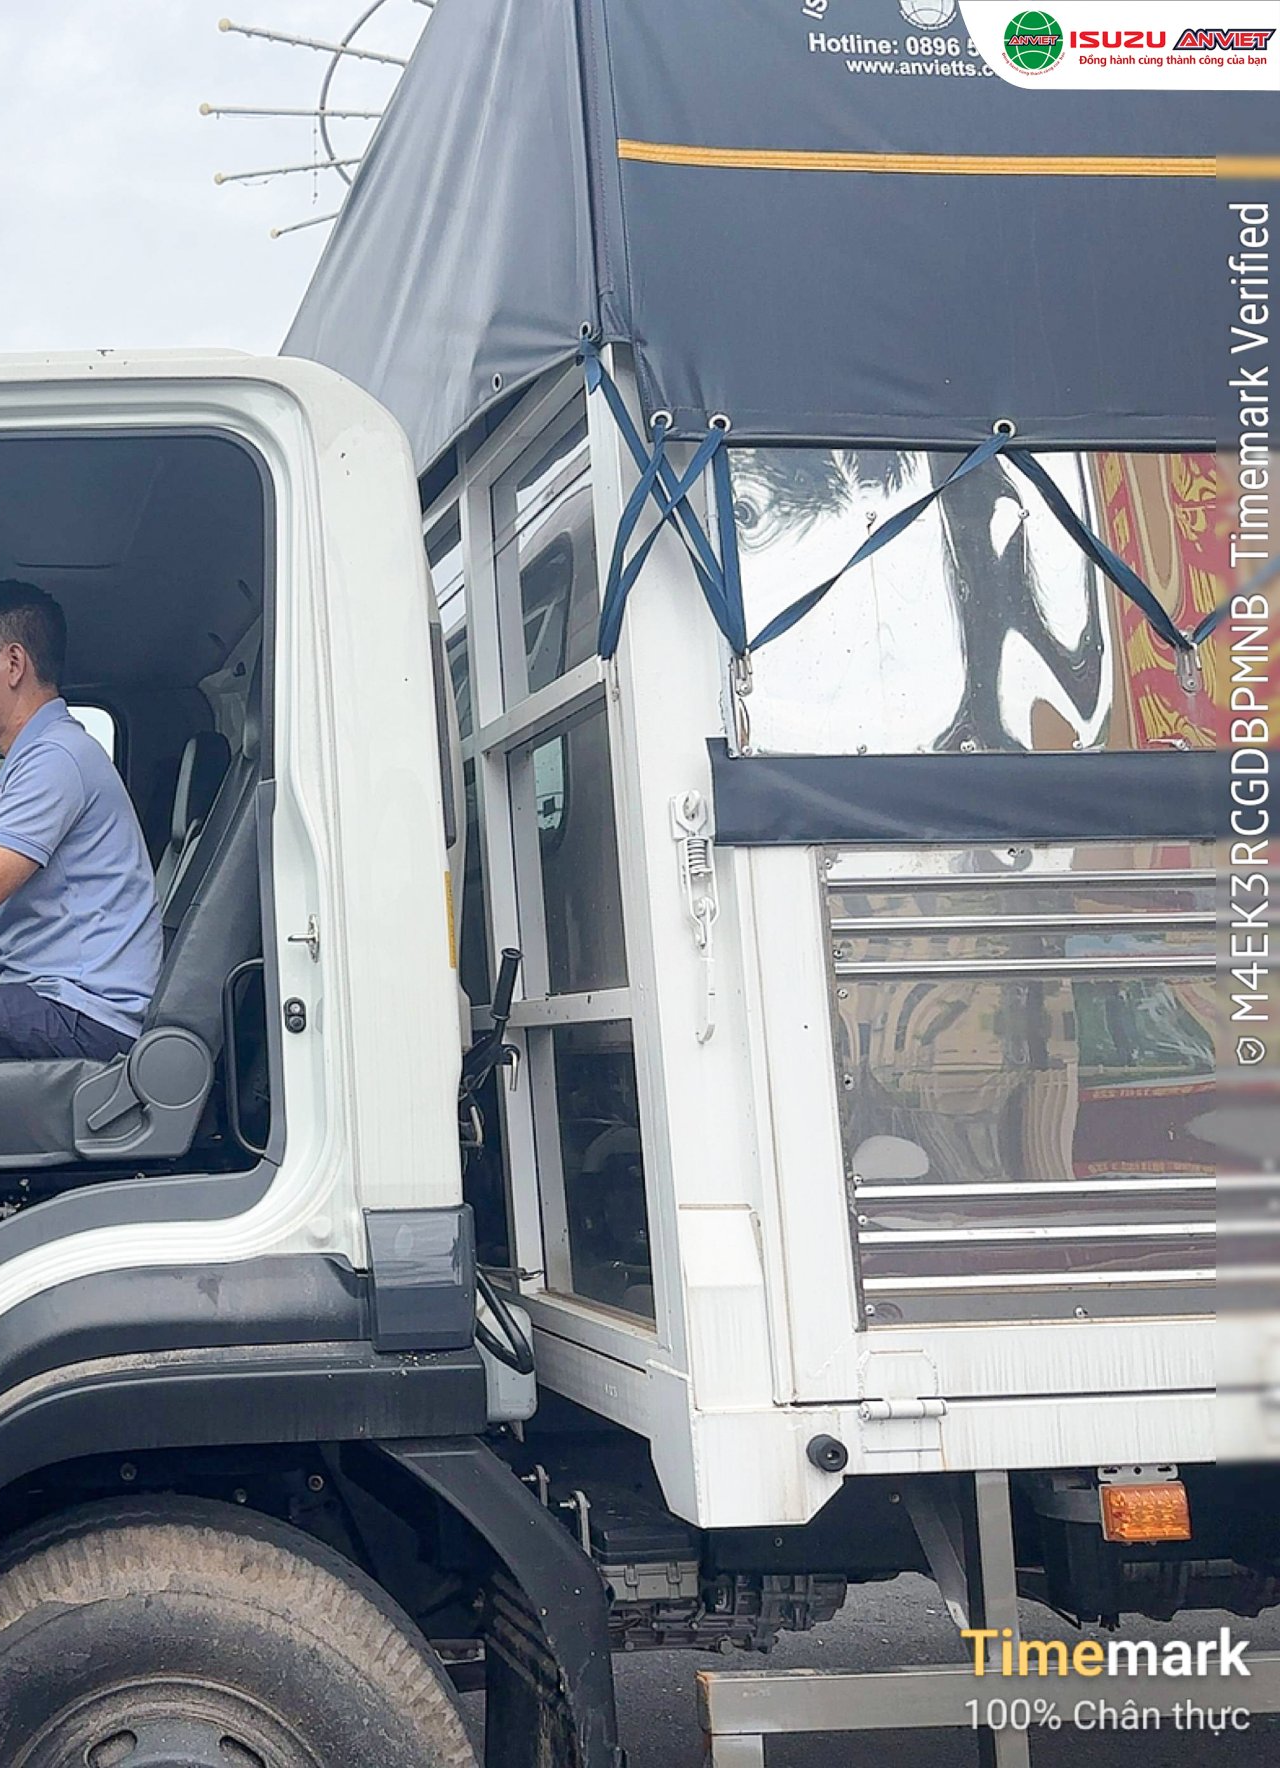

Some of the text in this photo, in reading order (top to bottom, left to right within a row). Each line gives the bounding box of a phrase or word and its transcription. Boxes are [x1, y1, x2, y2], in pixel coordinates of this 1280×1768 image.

[808, 32, 899, 54] Hotline:
[905, 36, 960, 57] 0896
[846, 59, 997, 77] www.anvietts.c
